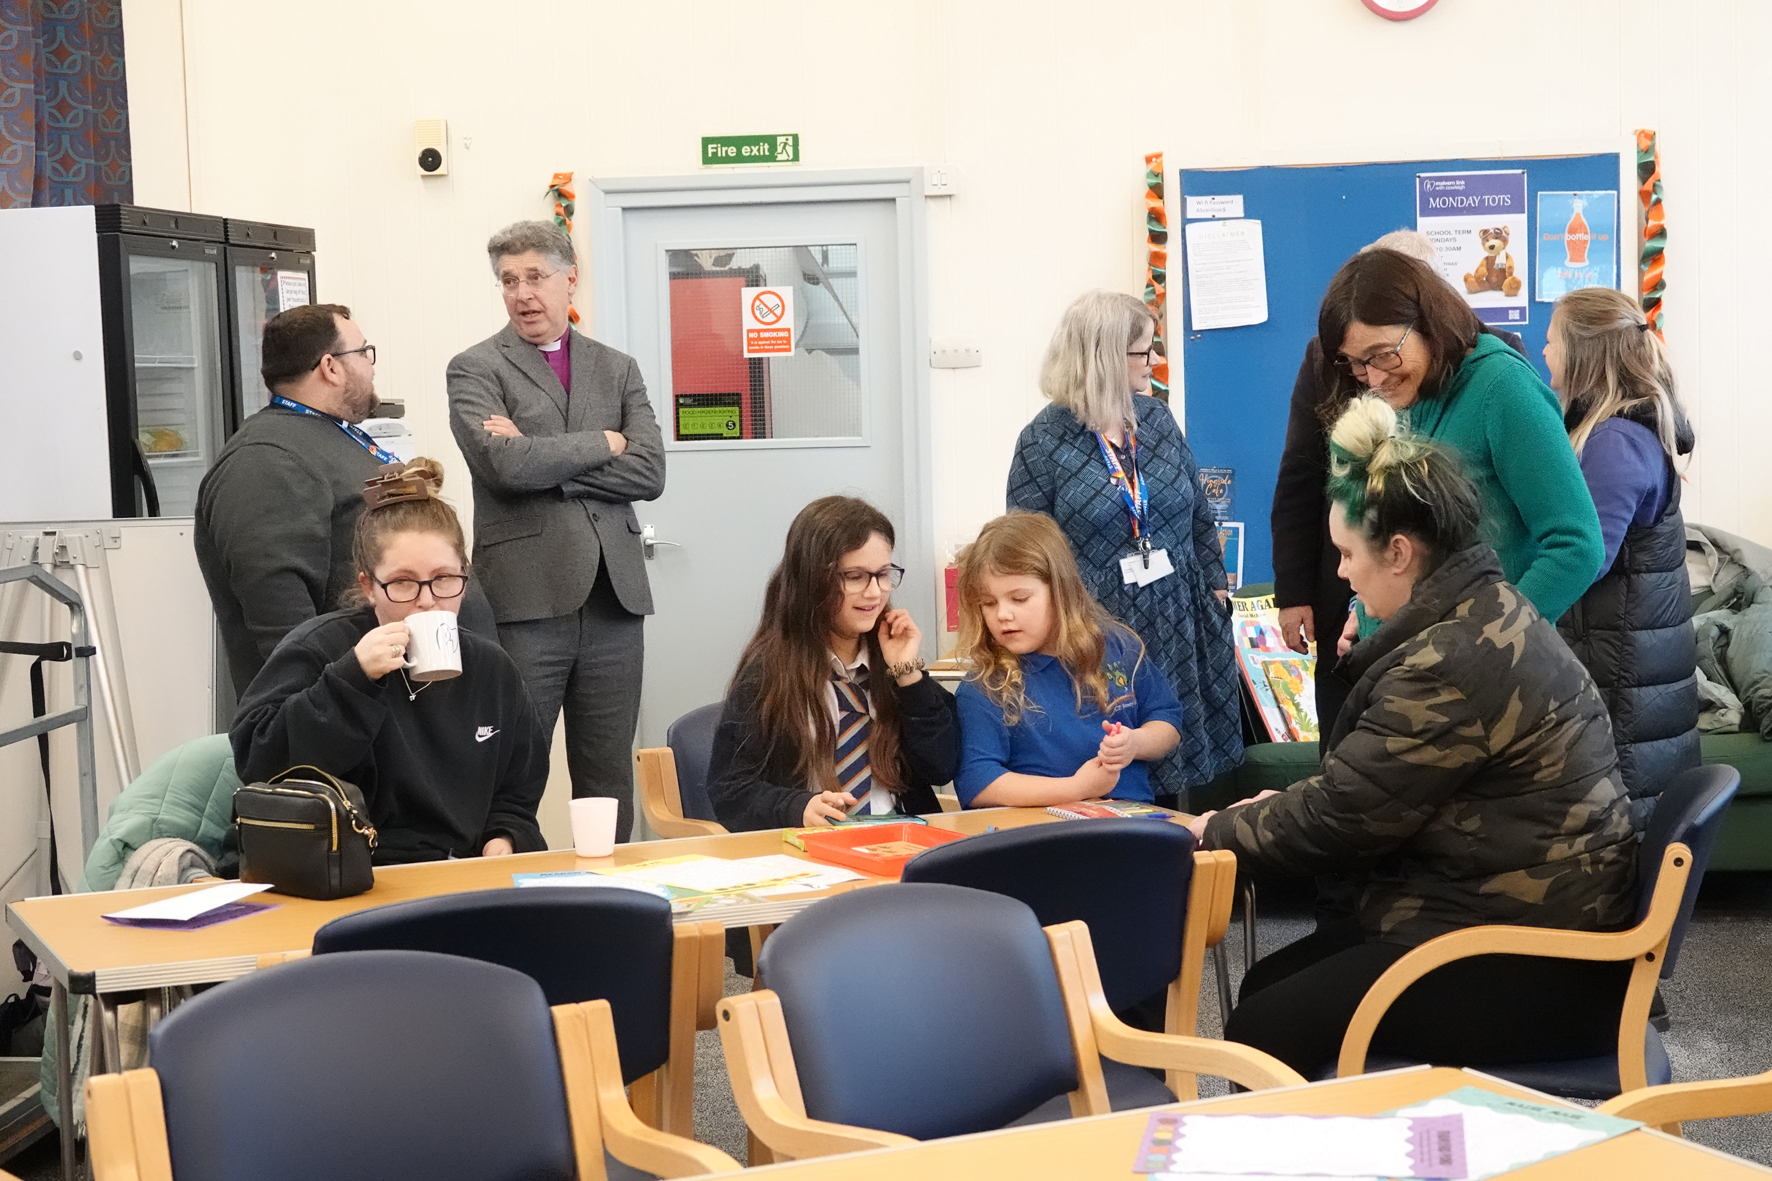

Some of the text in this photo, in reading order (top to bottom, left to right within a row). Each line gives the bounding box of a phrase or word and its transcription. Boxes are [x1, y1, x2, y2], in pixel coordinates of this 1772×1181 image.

[707, 142, 770, 158] Fire exit
[1429, 194, 1511, 209] MONDAY TOTS
[1198, 231, 1245, 240] DISCLAIMER
[1543, 232, 1565, 240] Don't
[1567, 232, 1589, 240] bottle
[1557, 270, 1573, 278] Talk
[281, 399, 297, 408] STAFF
[728, 421, 735, 430] 5
[1232, 599, 1249, 612] MER
[477, 725, 494, 736] NIKE
